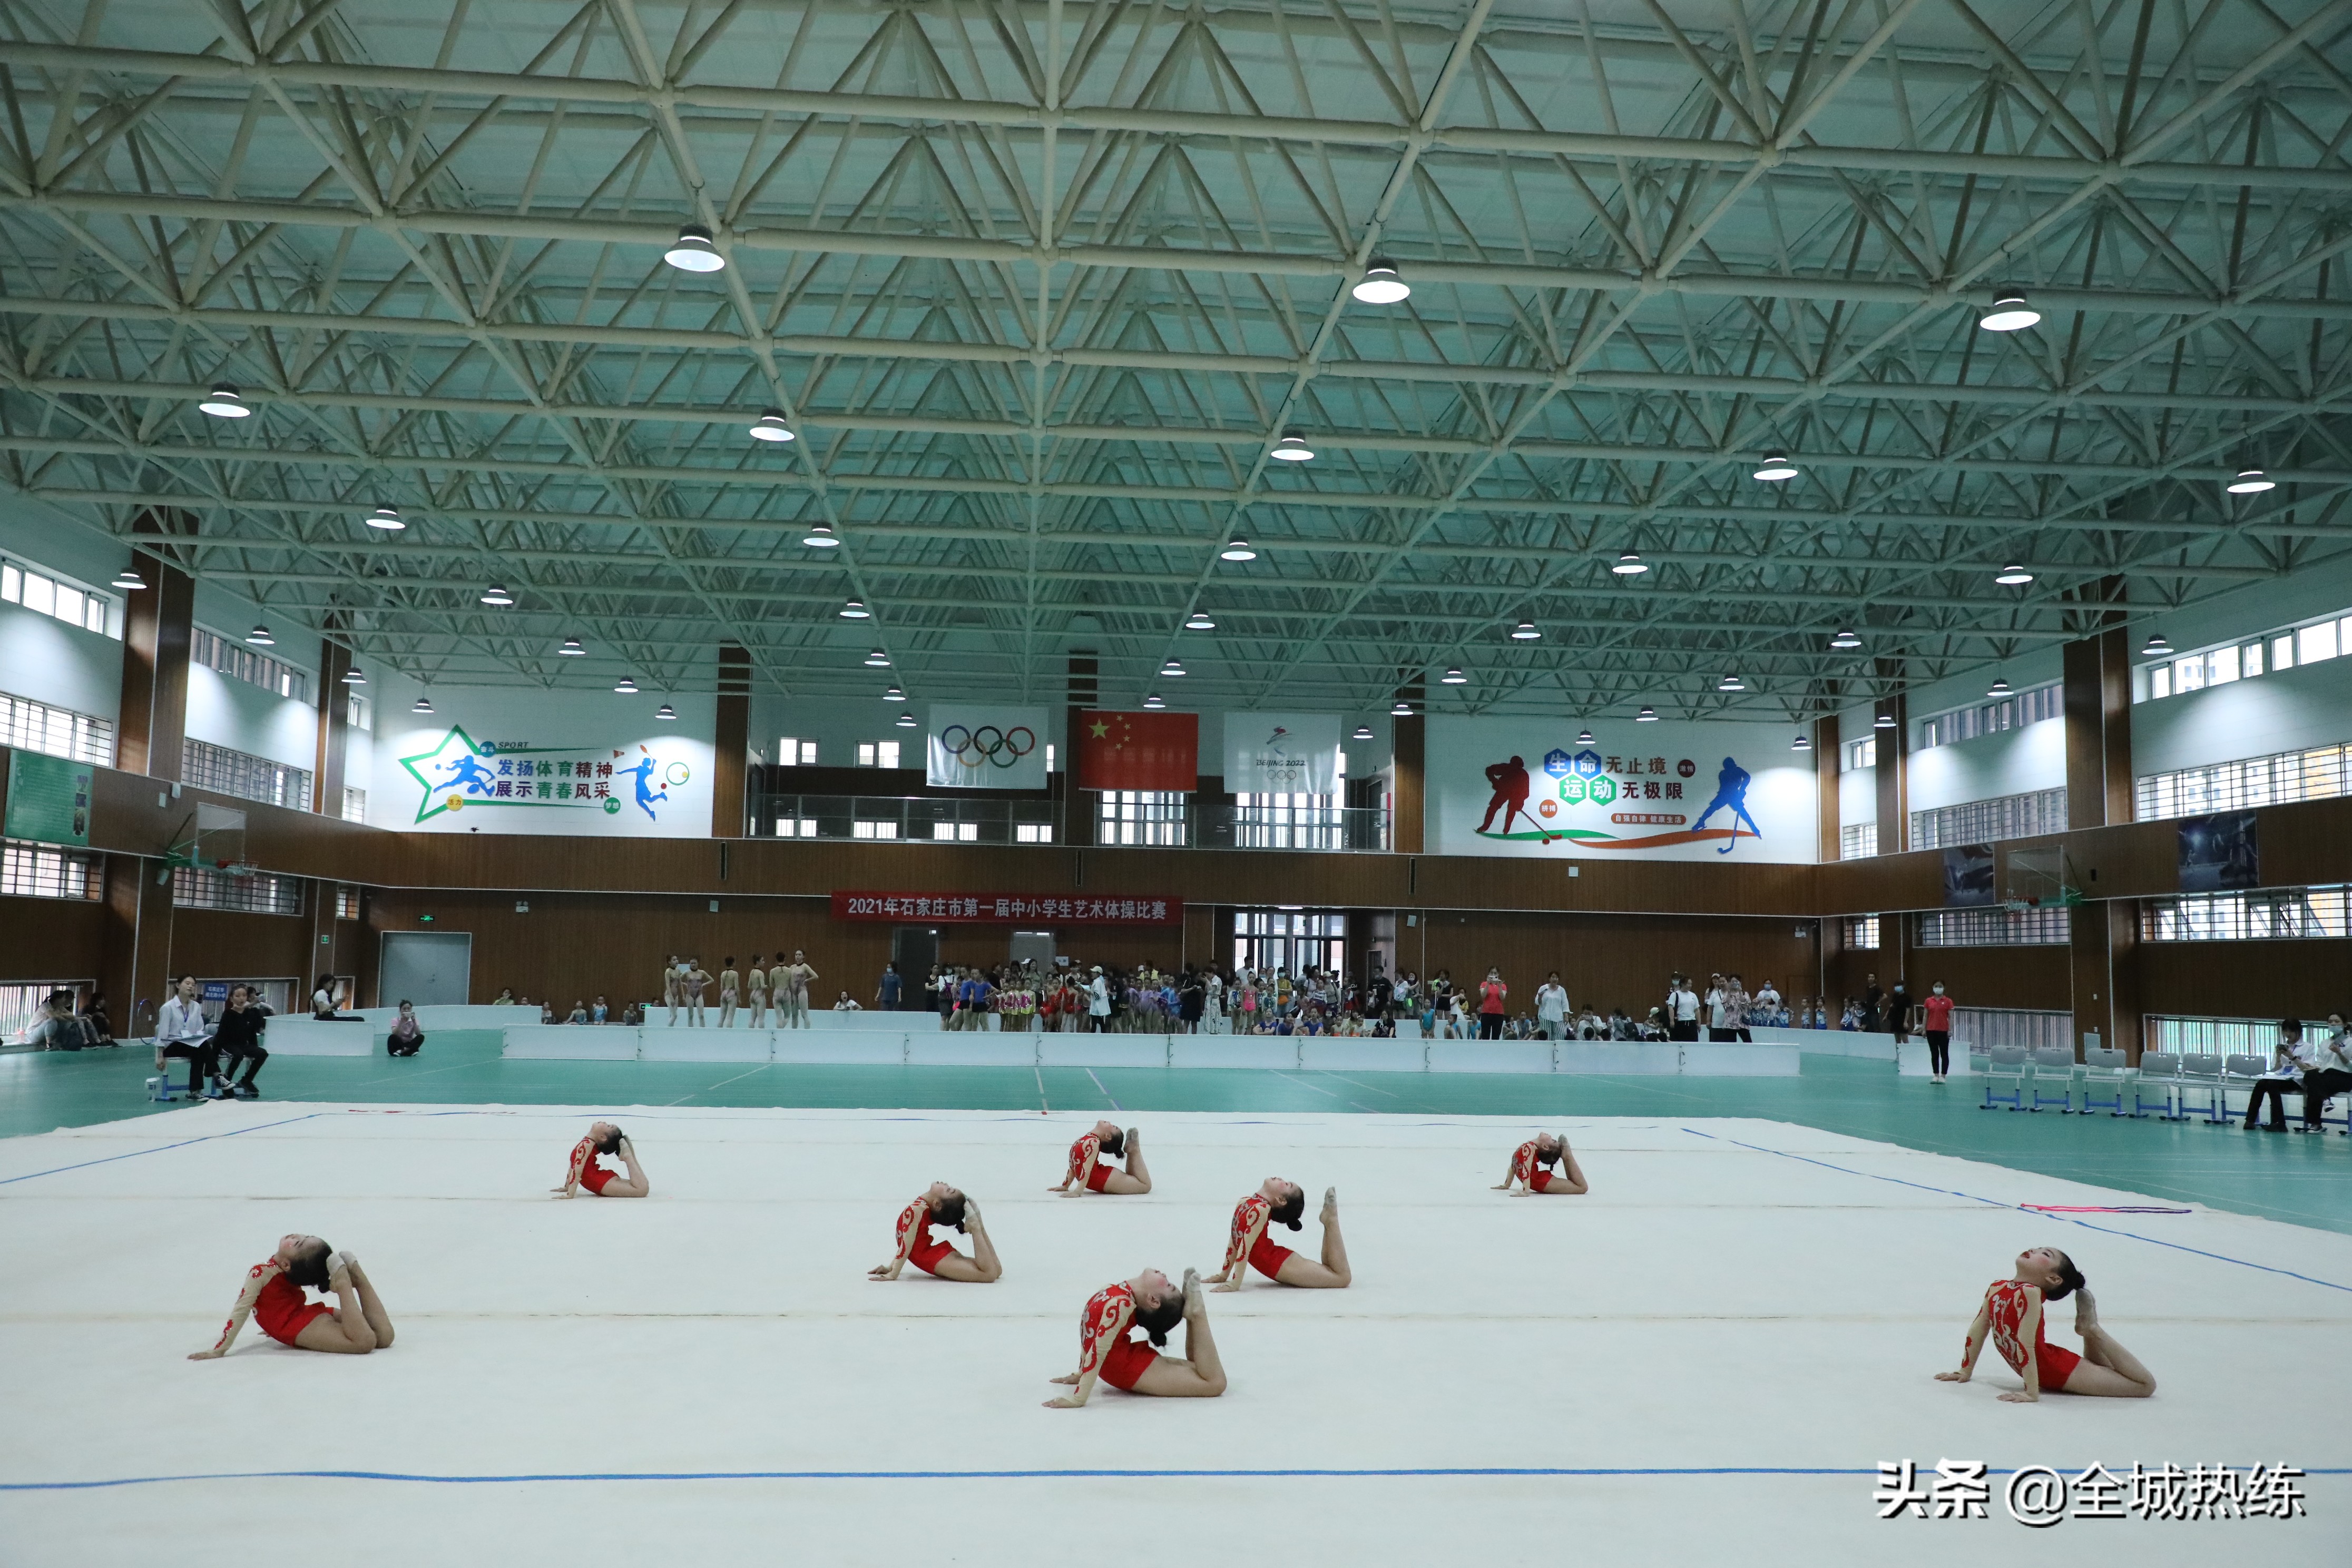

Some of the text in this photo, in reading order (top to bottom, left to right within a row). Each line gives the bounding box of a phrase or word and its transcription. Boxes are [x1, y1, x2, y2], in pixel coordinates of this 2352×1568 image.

[497, 759, 613, 778] 发扬体育精神
[1256, 759, 1283, 768] BEIJING
[1549, 753, 1667, 775] 生命无止境
[495, 781, 610, 799] 展示青春风采
[1564, 779, 1683, 800] 运动无极限
[848, 897, 1166, 919] 2021年石家庄市第一届中小学生艺术体操比赛
